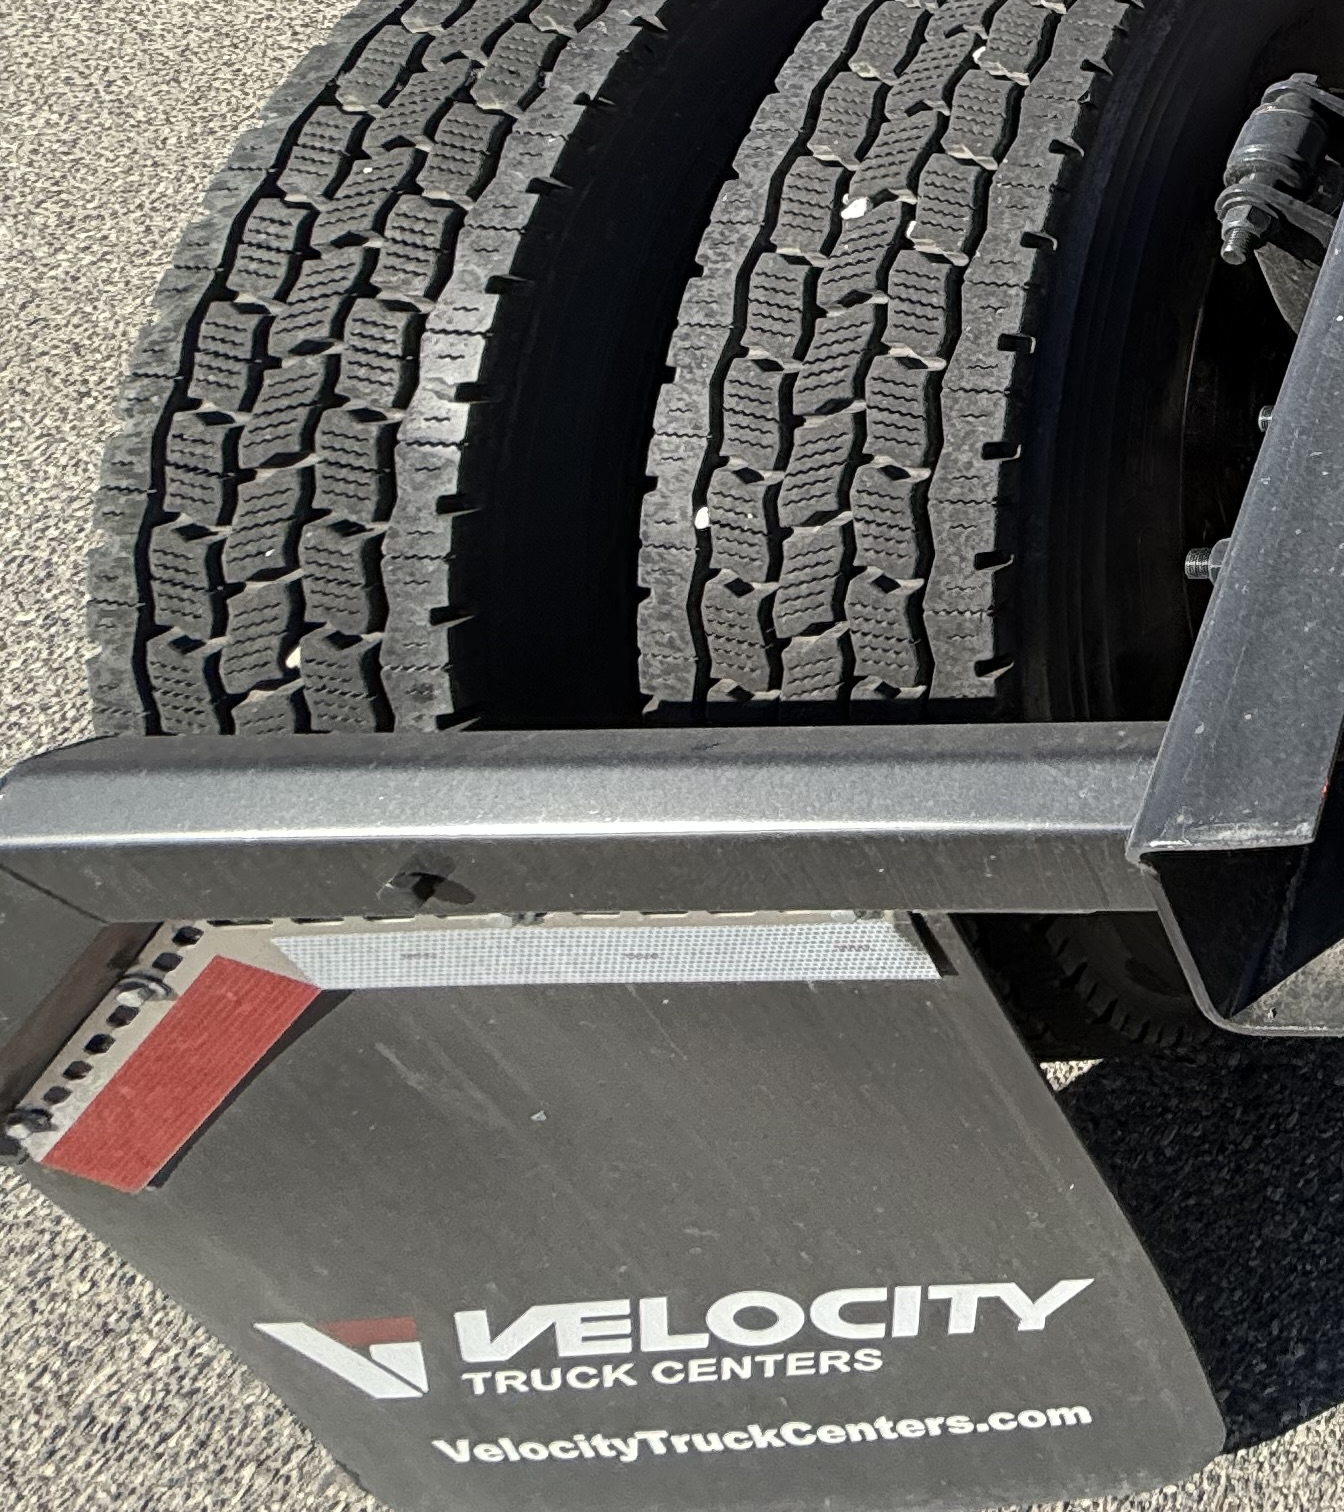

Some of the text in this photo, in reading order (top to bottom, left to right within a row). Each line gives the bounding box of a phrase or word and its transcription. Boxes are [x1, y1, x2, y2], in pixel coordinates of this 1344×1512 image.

[453, 1278, 1095, 1364] VELOCITY
[461, 1348, 884, 1395] TRUCK CENTERS
[431, 1405, 1093, 1464] VelocityTruckCenters.com
